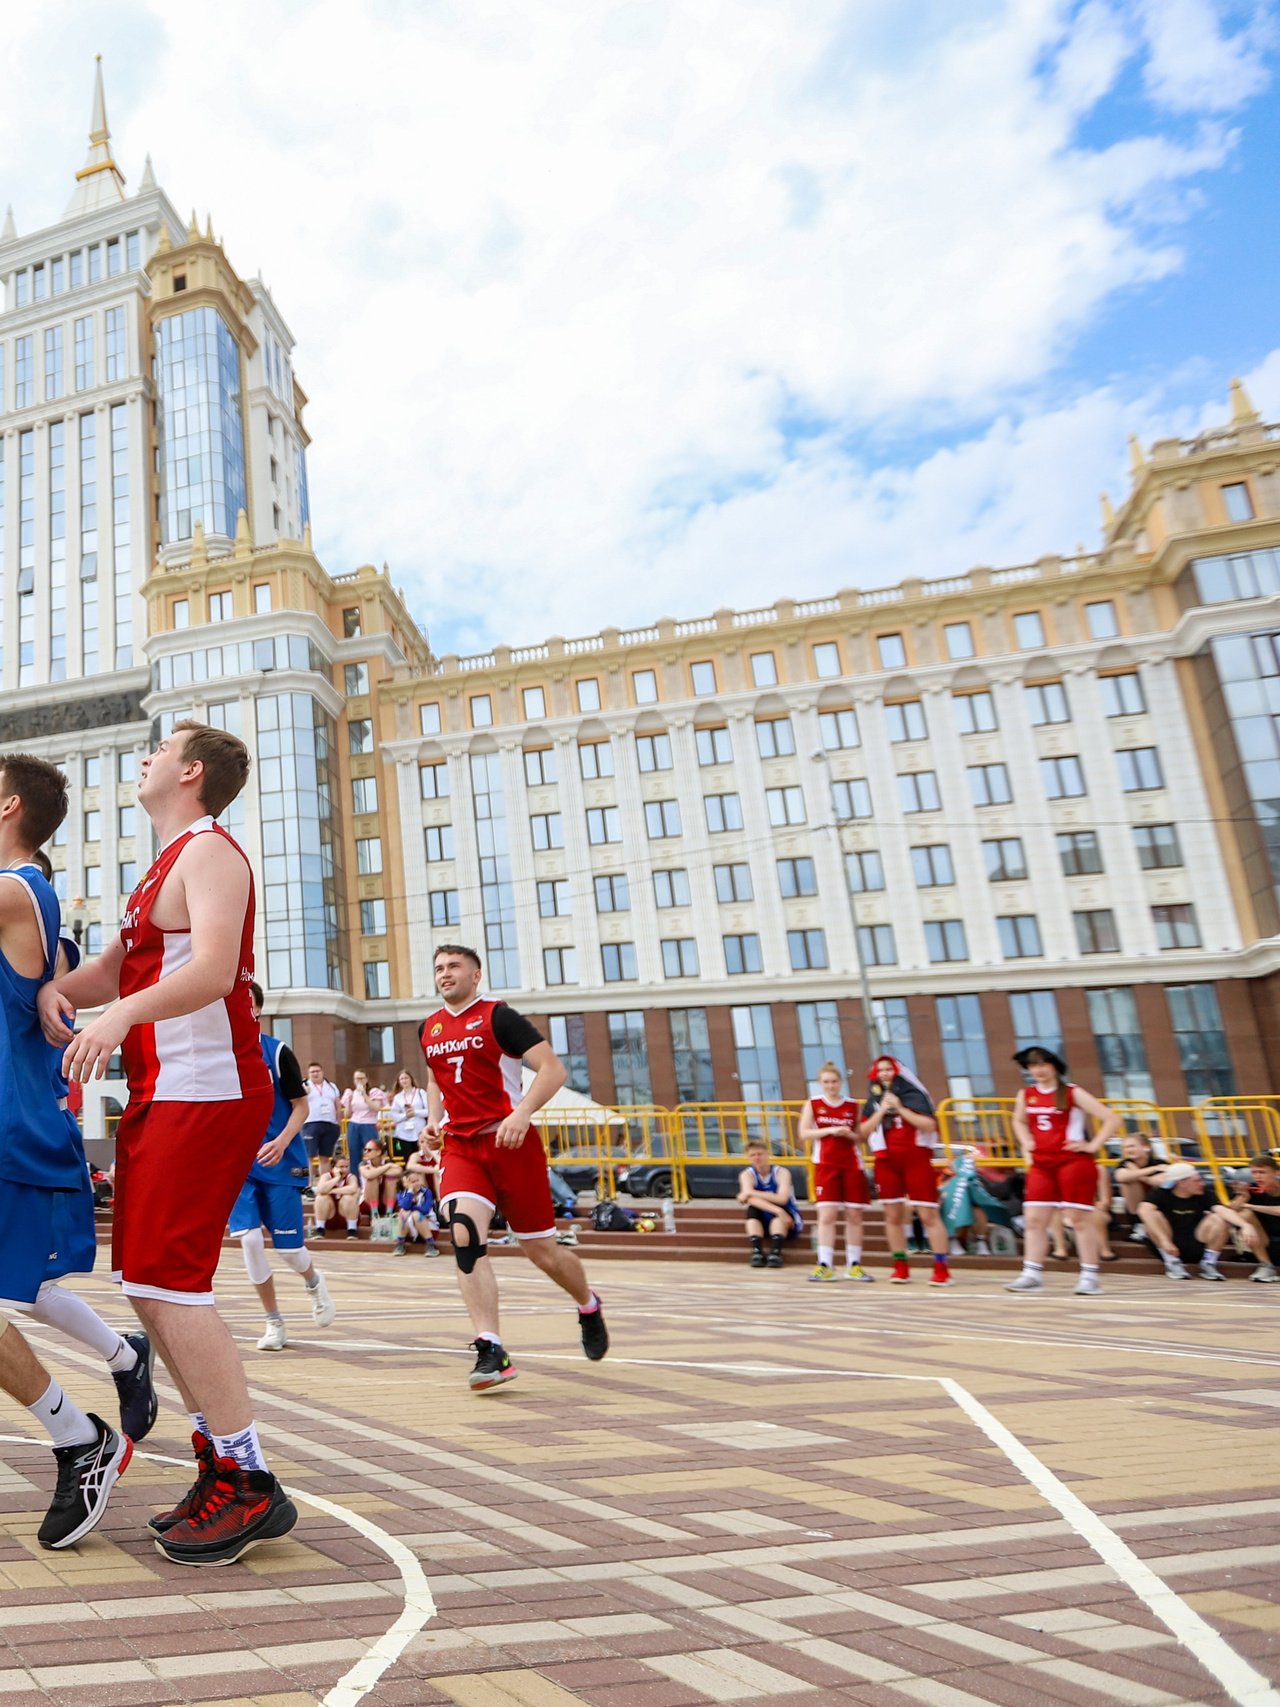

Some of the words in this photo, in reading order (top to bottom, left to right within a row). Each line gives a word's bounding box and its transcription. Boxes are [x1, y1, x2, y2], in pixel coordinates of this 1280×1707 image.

[426, 1036, 484, 1059] РАНХиГС
[446, 1055, 465, 1084] 7
[1036, 1115, 1053, 1131] 5
